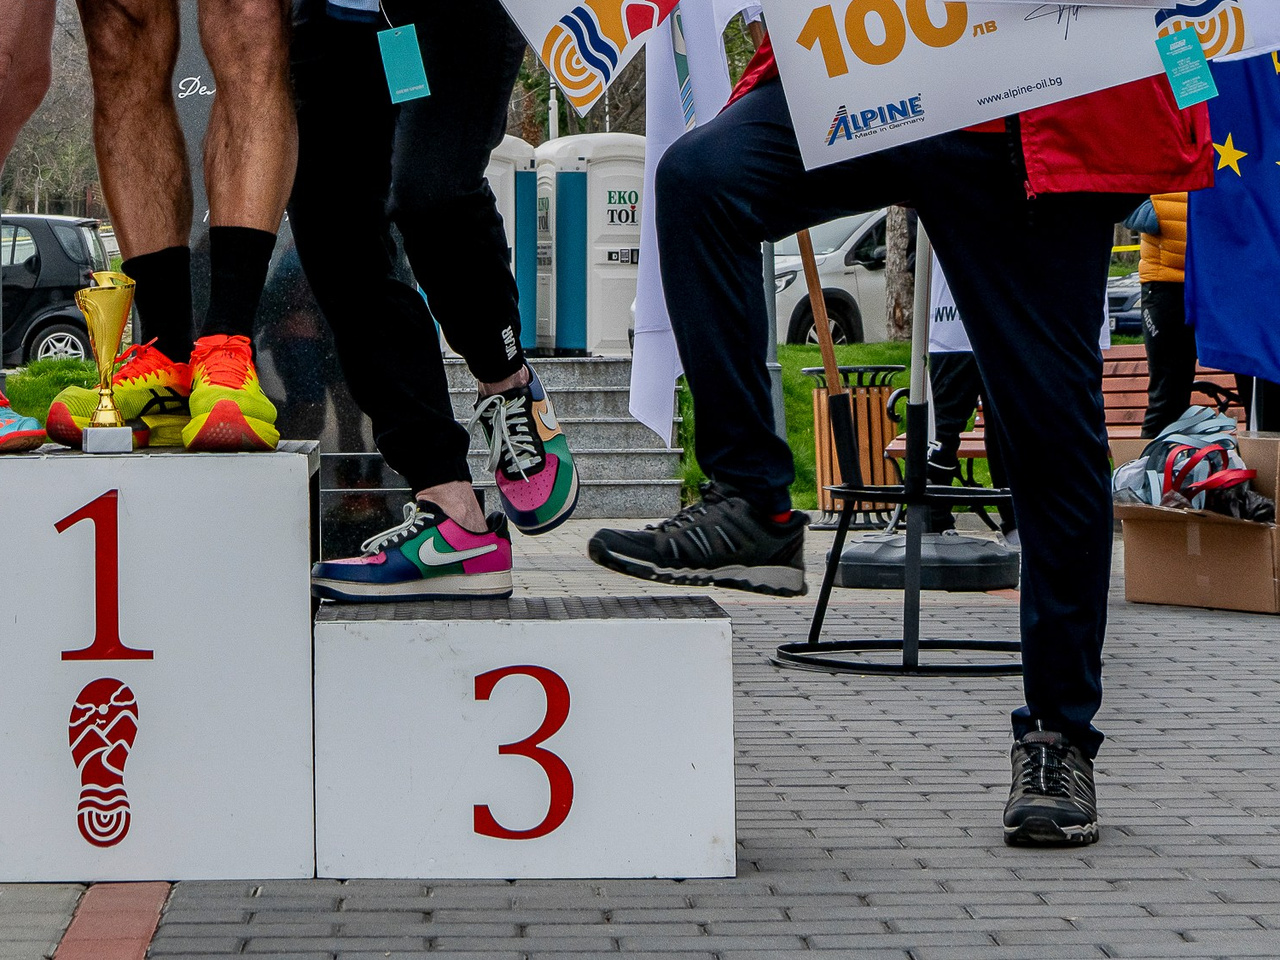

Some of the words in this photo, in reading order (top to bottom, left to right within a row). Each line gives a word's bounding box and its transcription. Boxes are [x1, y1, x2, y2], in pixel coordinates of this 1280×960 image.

[972, 20, 998, 38] лв
[977, 77, 1063, 106] www.alpine-oil.bg
[824, 94, 925, 146] ALPINE
[854, 131, 878, 140] Made
[889, 116, 925, 130] Germany
[502, 325, 517, 361] WEAR
[54, 488, 154, 661] 1
[472, 663, 574, 841] 3
